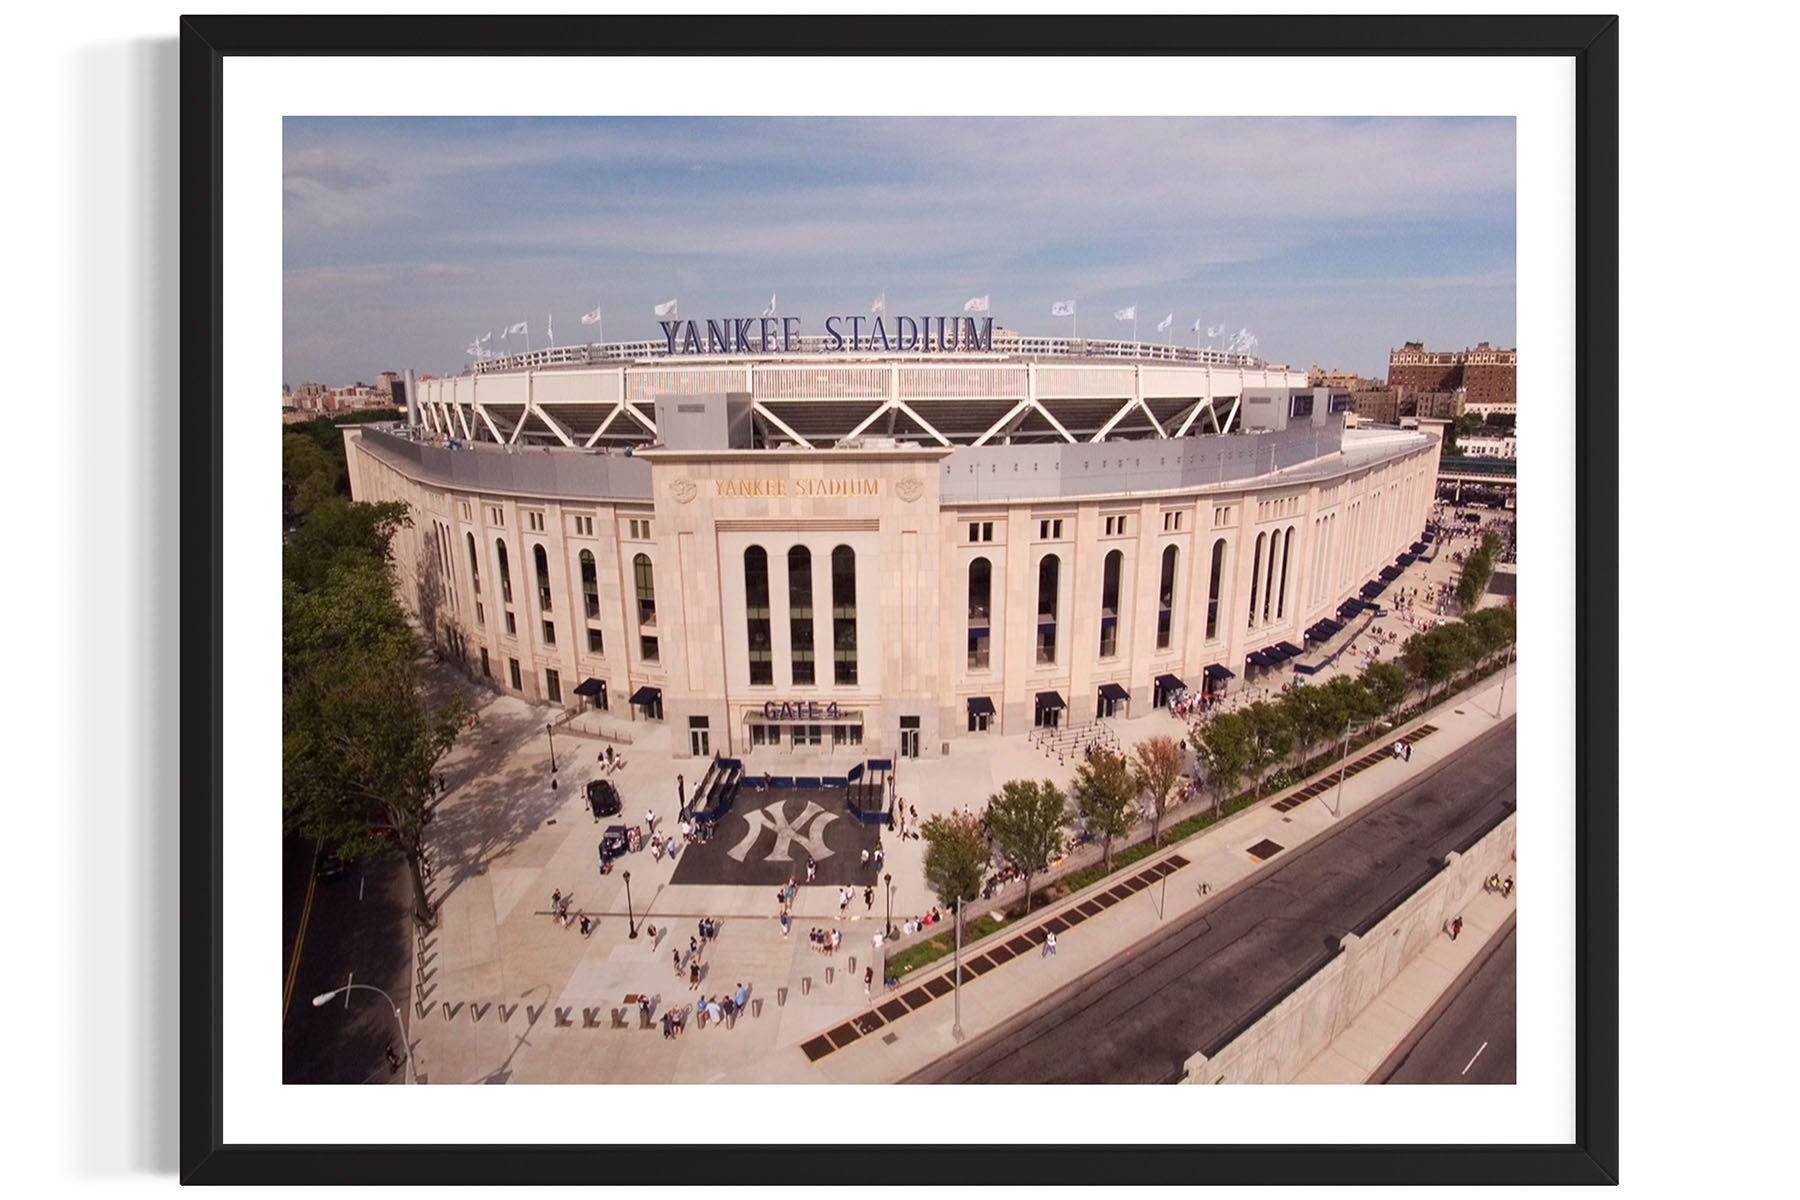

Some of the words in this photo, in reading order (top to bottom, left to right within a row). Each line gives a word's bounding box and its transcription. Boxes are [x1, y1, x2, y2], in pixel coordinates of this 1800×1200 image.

[659, 316, 801, 354] YANKEE
[825, 315, 995, 351] STADIUM
[714, 479, 786, 497] YANKEE
[796, 478, 880, 497] STADIUM
[764, 701, 820, 721] GATE
[826, 701, 840, 719] 4
